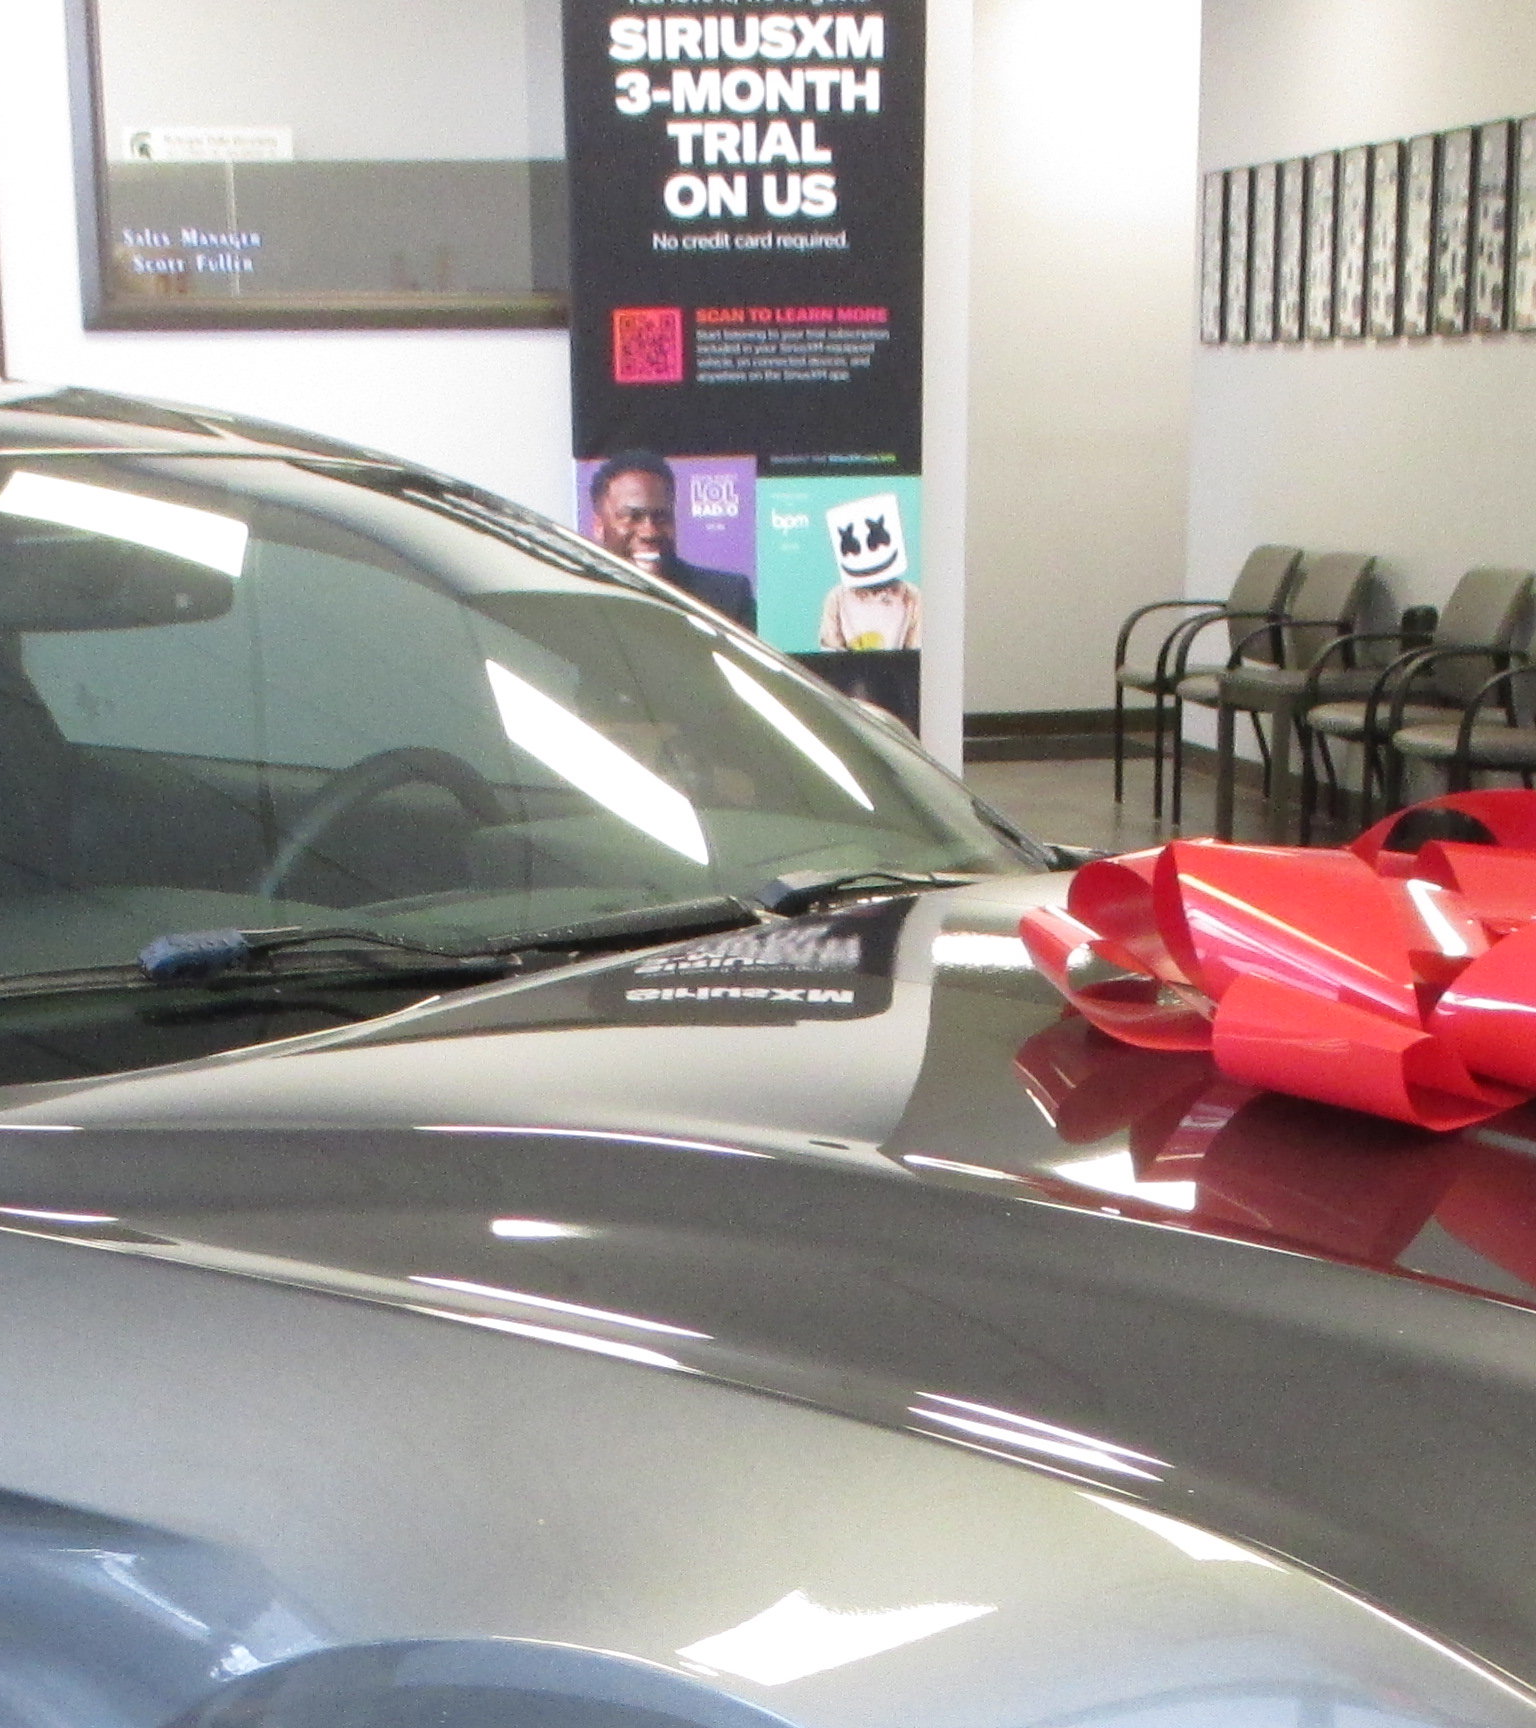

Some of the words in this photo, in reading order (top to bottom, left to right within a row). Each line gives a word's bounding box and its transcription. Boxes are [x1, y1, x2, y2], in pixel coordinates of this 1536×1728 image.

[608, 14, 885, 61] SIRIUSXM
[614, 68, 881, 115] 3-MONTH
[666, 120, 833, 165] TRIAL
[663, 173, 748, 218] ON
[763, 173, 838, 218] US
[652, 231, 678, 250] No
[681, 231, 731, 250] credit
[733, 231, 773, 250] card
[776, 231, 850, 252] required.
[695, 306, 746, 323] SCAN
[749, 306, 773, 323] TO
[775, 306, 835, 323] LEARN
[837, 306, 889, 323] MORE
[771, 507, 810, 536] bpm
